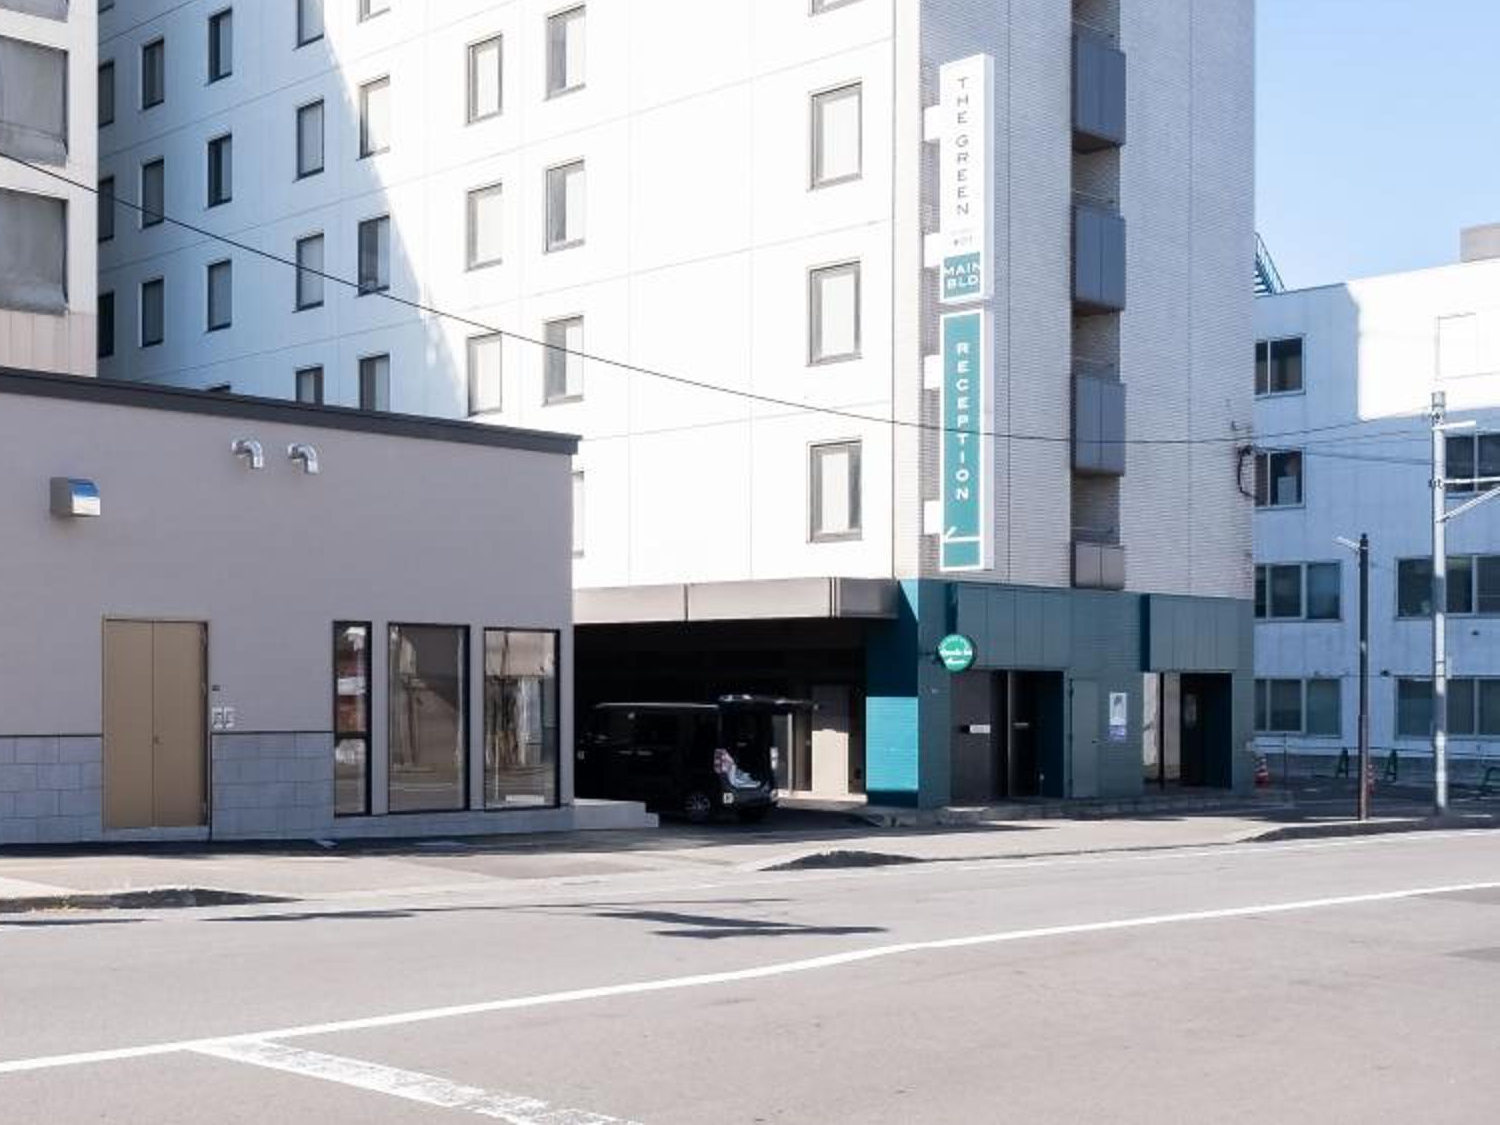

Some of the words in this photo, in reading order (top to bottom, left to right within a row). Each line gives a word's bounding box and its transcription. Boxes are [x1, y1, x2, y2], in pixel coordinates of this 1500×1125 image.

[957, 76, 970, 125] THE
[955, 134, 970, 216] GREEN
[955, 341, 970, 500] RECEPTION
